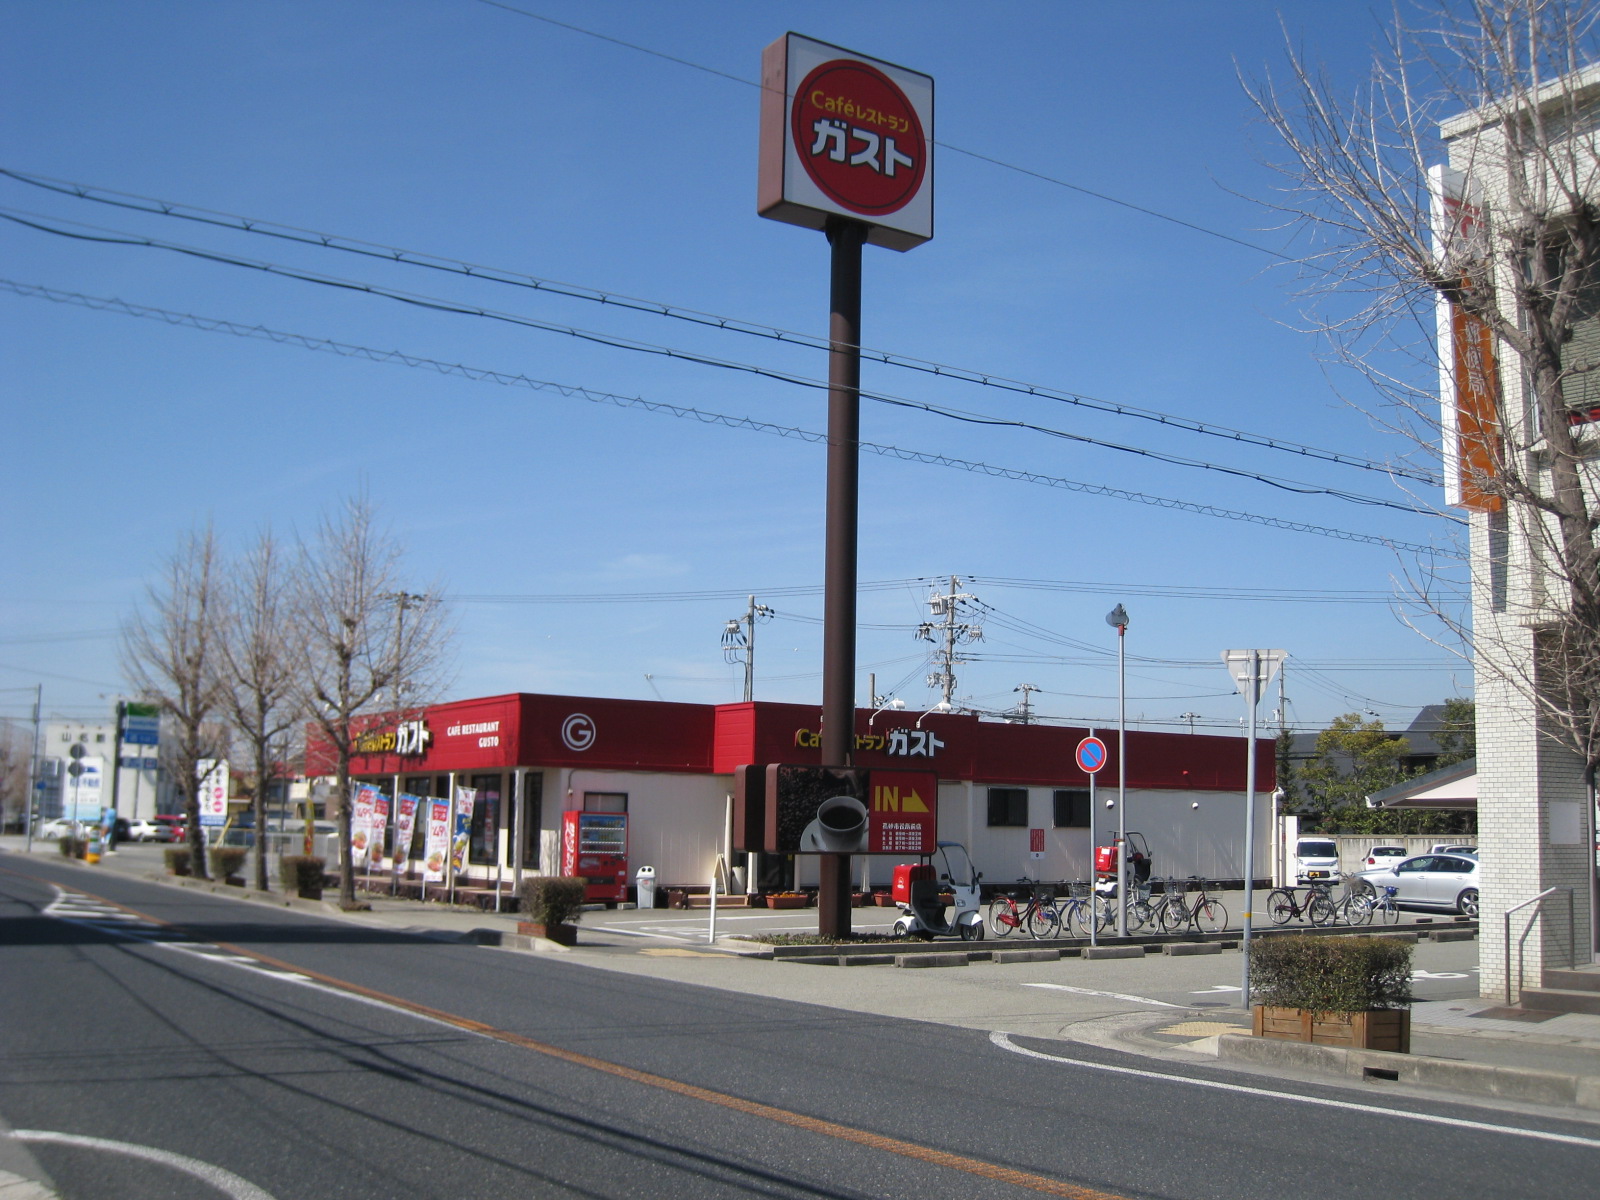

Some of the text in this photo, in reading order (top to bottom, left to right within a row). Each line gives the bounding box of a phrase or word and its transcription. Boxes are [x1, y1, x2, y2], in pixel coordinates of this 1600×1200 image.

[811, 118, 913, 177] ガスト
[461, 720, 500, 735] RESTAURANT
[565, 717, 592, 747] G
[478, 736, 500, 748] GUSTO
[888, 728, 945, 757] ガスト
[874, 785, 899, 812] IN
